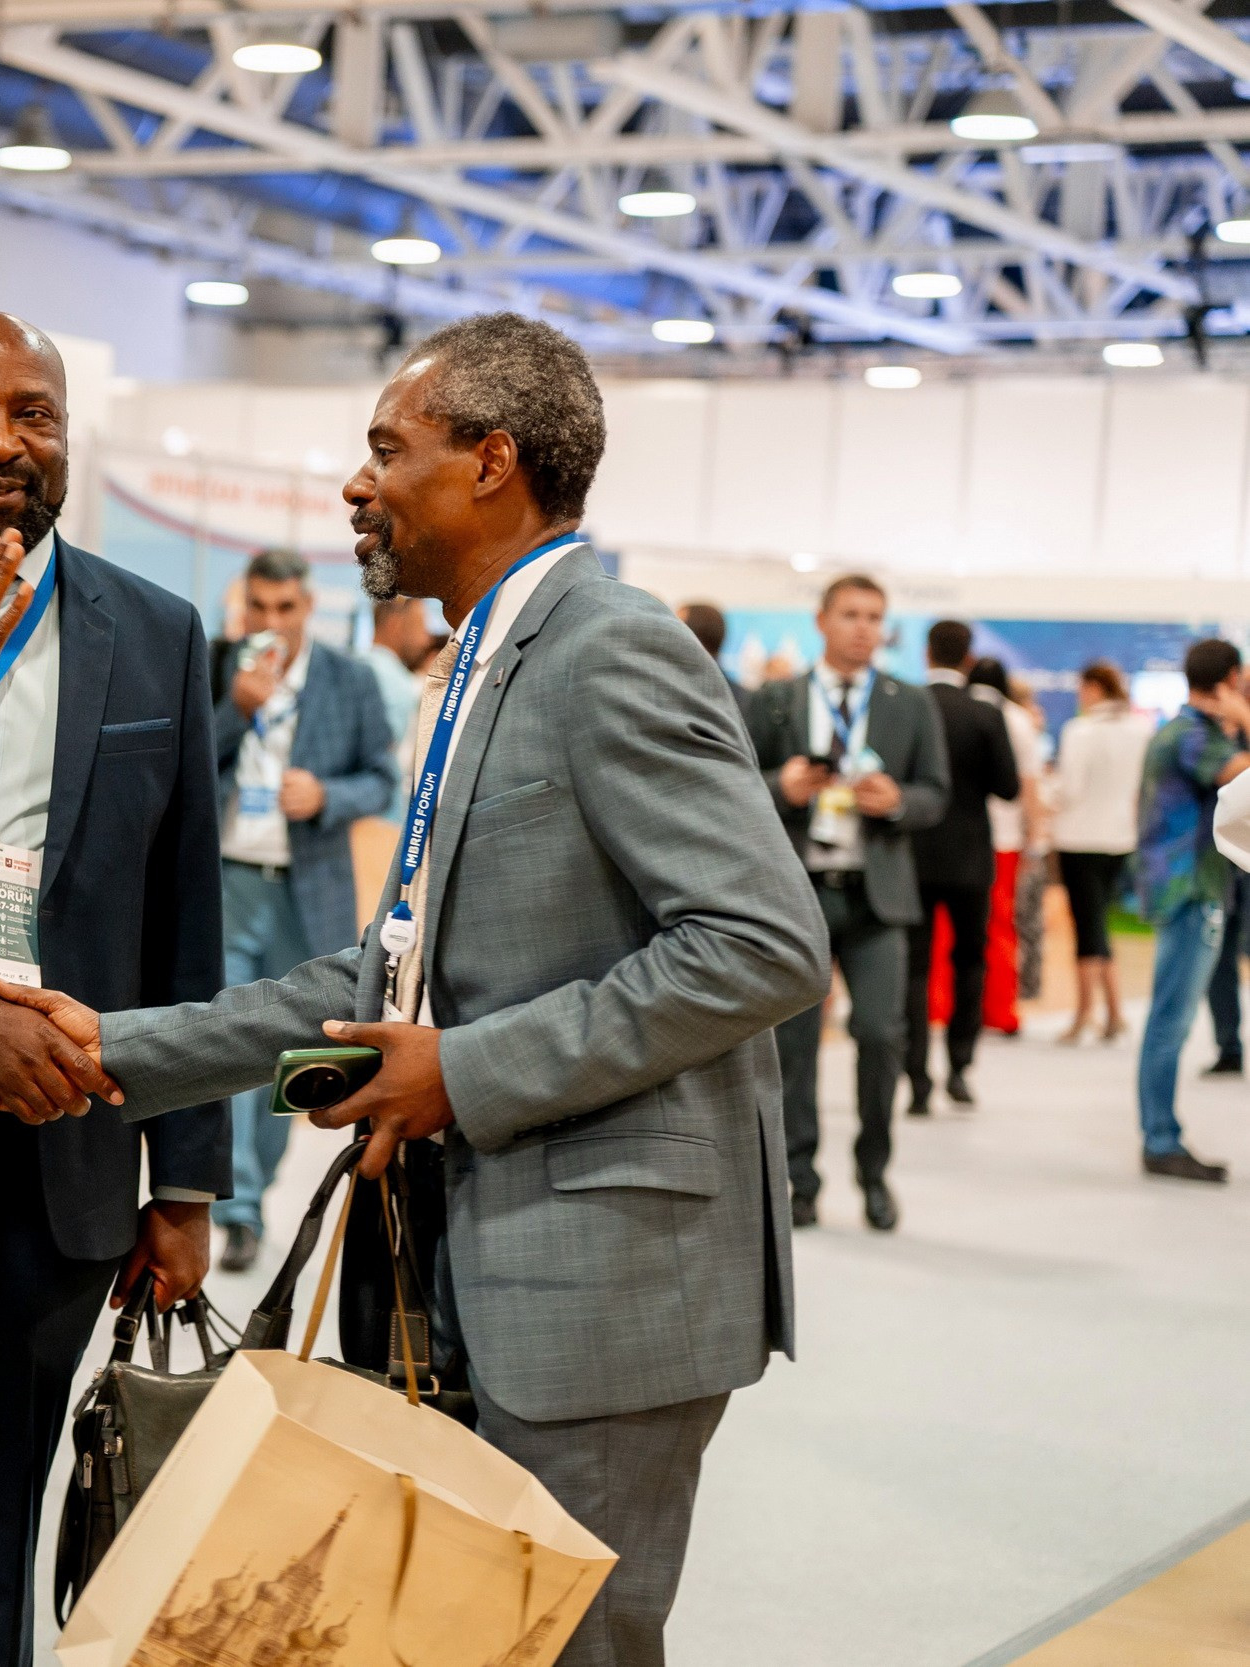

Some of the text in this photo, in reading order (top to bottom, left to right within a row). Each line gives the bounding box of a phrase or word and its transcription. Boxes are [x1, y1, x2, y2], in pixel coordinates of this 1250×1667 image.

[443, 626, 479, 721] IMBRICS FORUM
[405, 772, 437, 867] IMBRICS FORUM
[2, 883, 32, 894] MUNICIPAL
